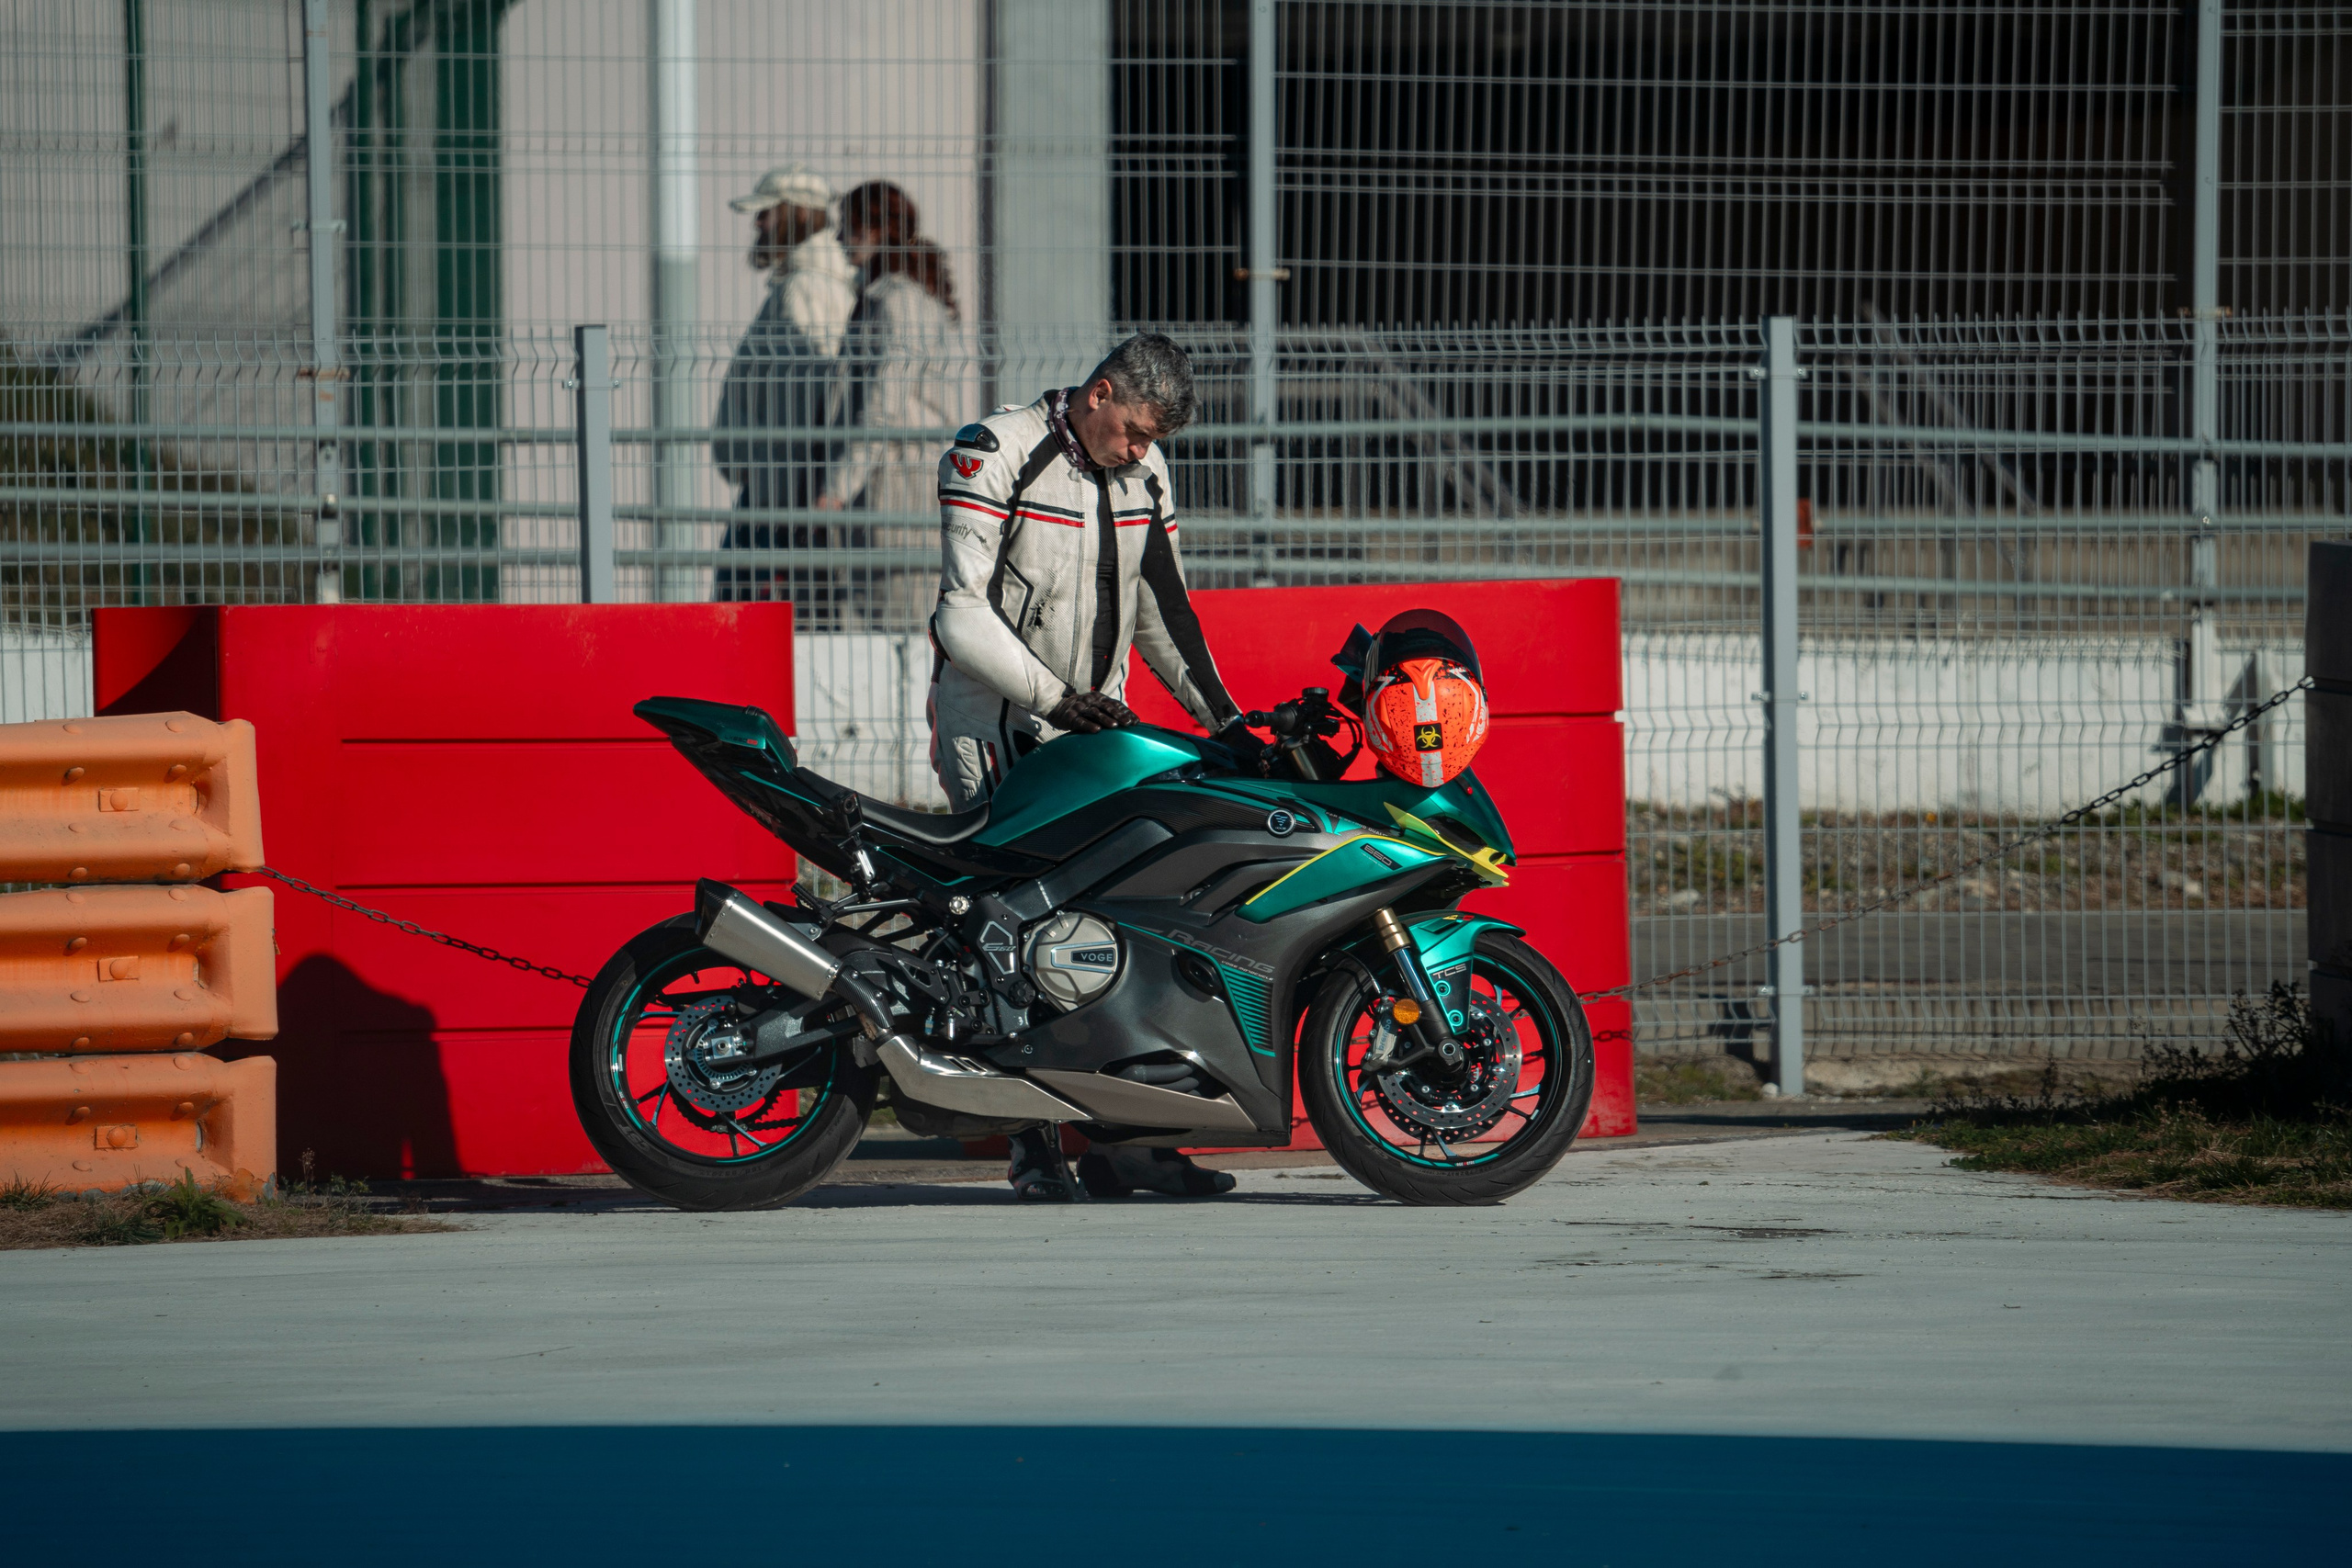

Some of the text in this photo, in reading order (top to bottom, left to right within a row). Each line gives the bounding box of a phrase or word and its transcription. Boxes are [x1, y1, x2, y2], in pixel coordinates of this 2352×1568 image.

[1080, 952, 1114, 963] VOGE
[1432, 963, 1467, 979] TCS
[1379, 1019, 1392, 1051] brembo
[617, 1123, 650, 1151] CST
